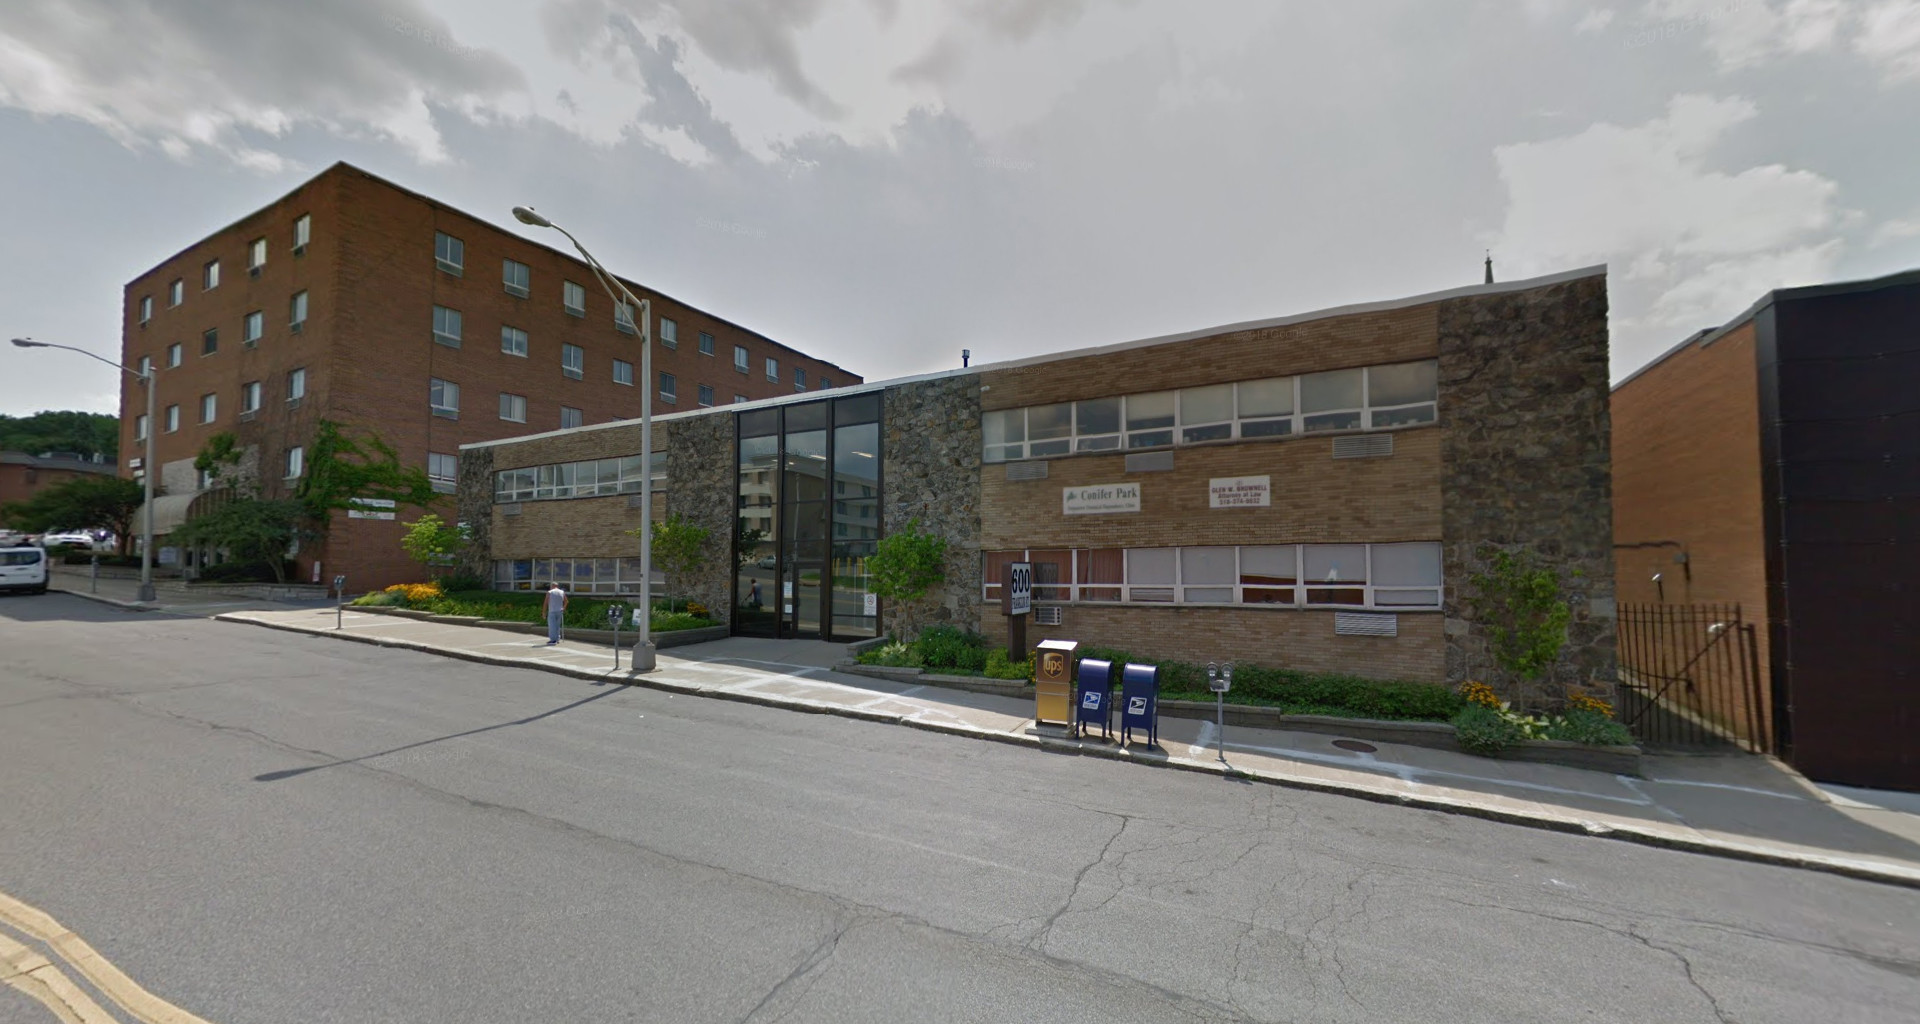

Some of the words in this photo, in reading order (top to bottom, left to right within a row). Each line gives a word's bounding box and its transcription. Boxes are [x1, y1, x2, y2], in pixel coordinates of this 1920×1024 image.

[1081, 487, 1112, 501] Conifer
[1116, 487, 1138, 499] Park
[1012, 568, 1030, 593] 600
[1045, 660, 1063, 675] ups
